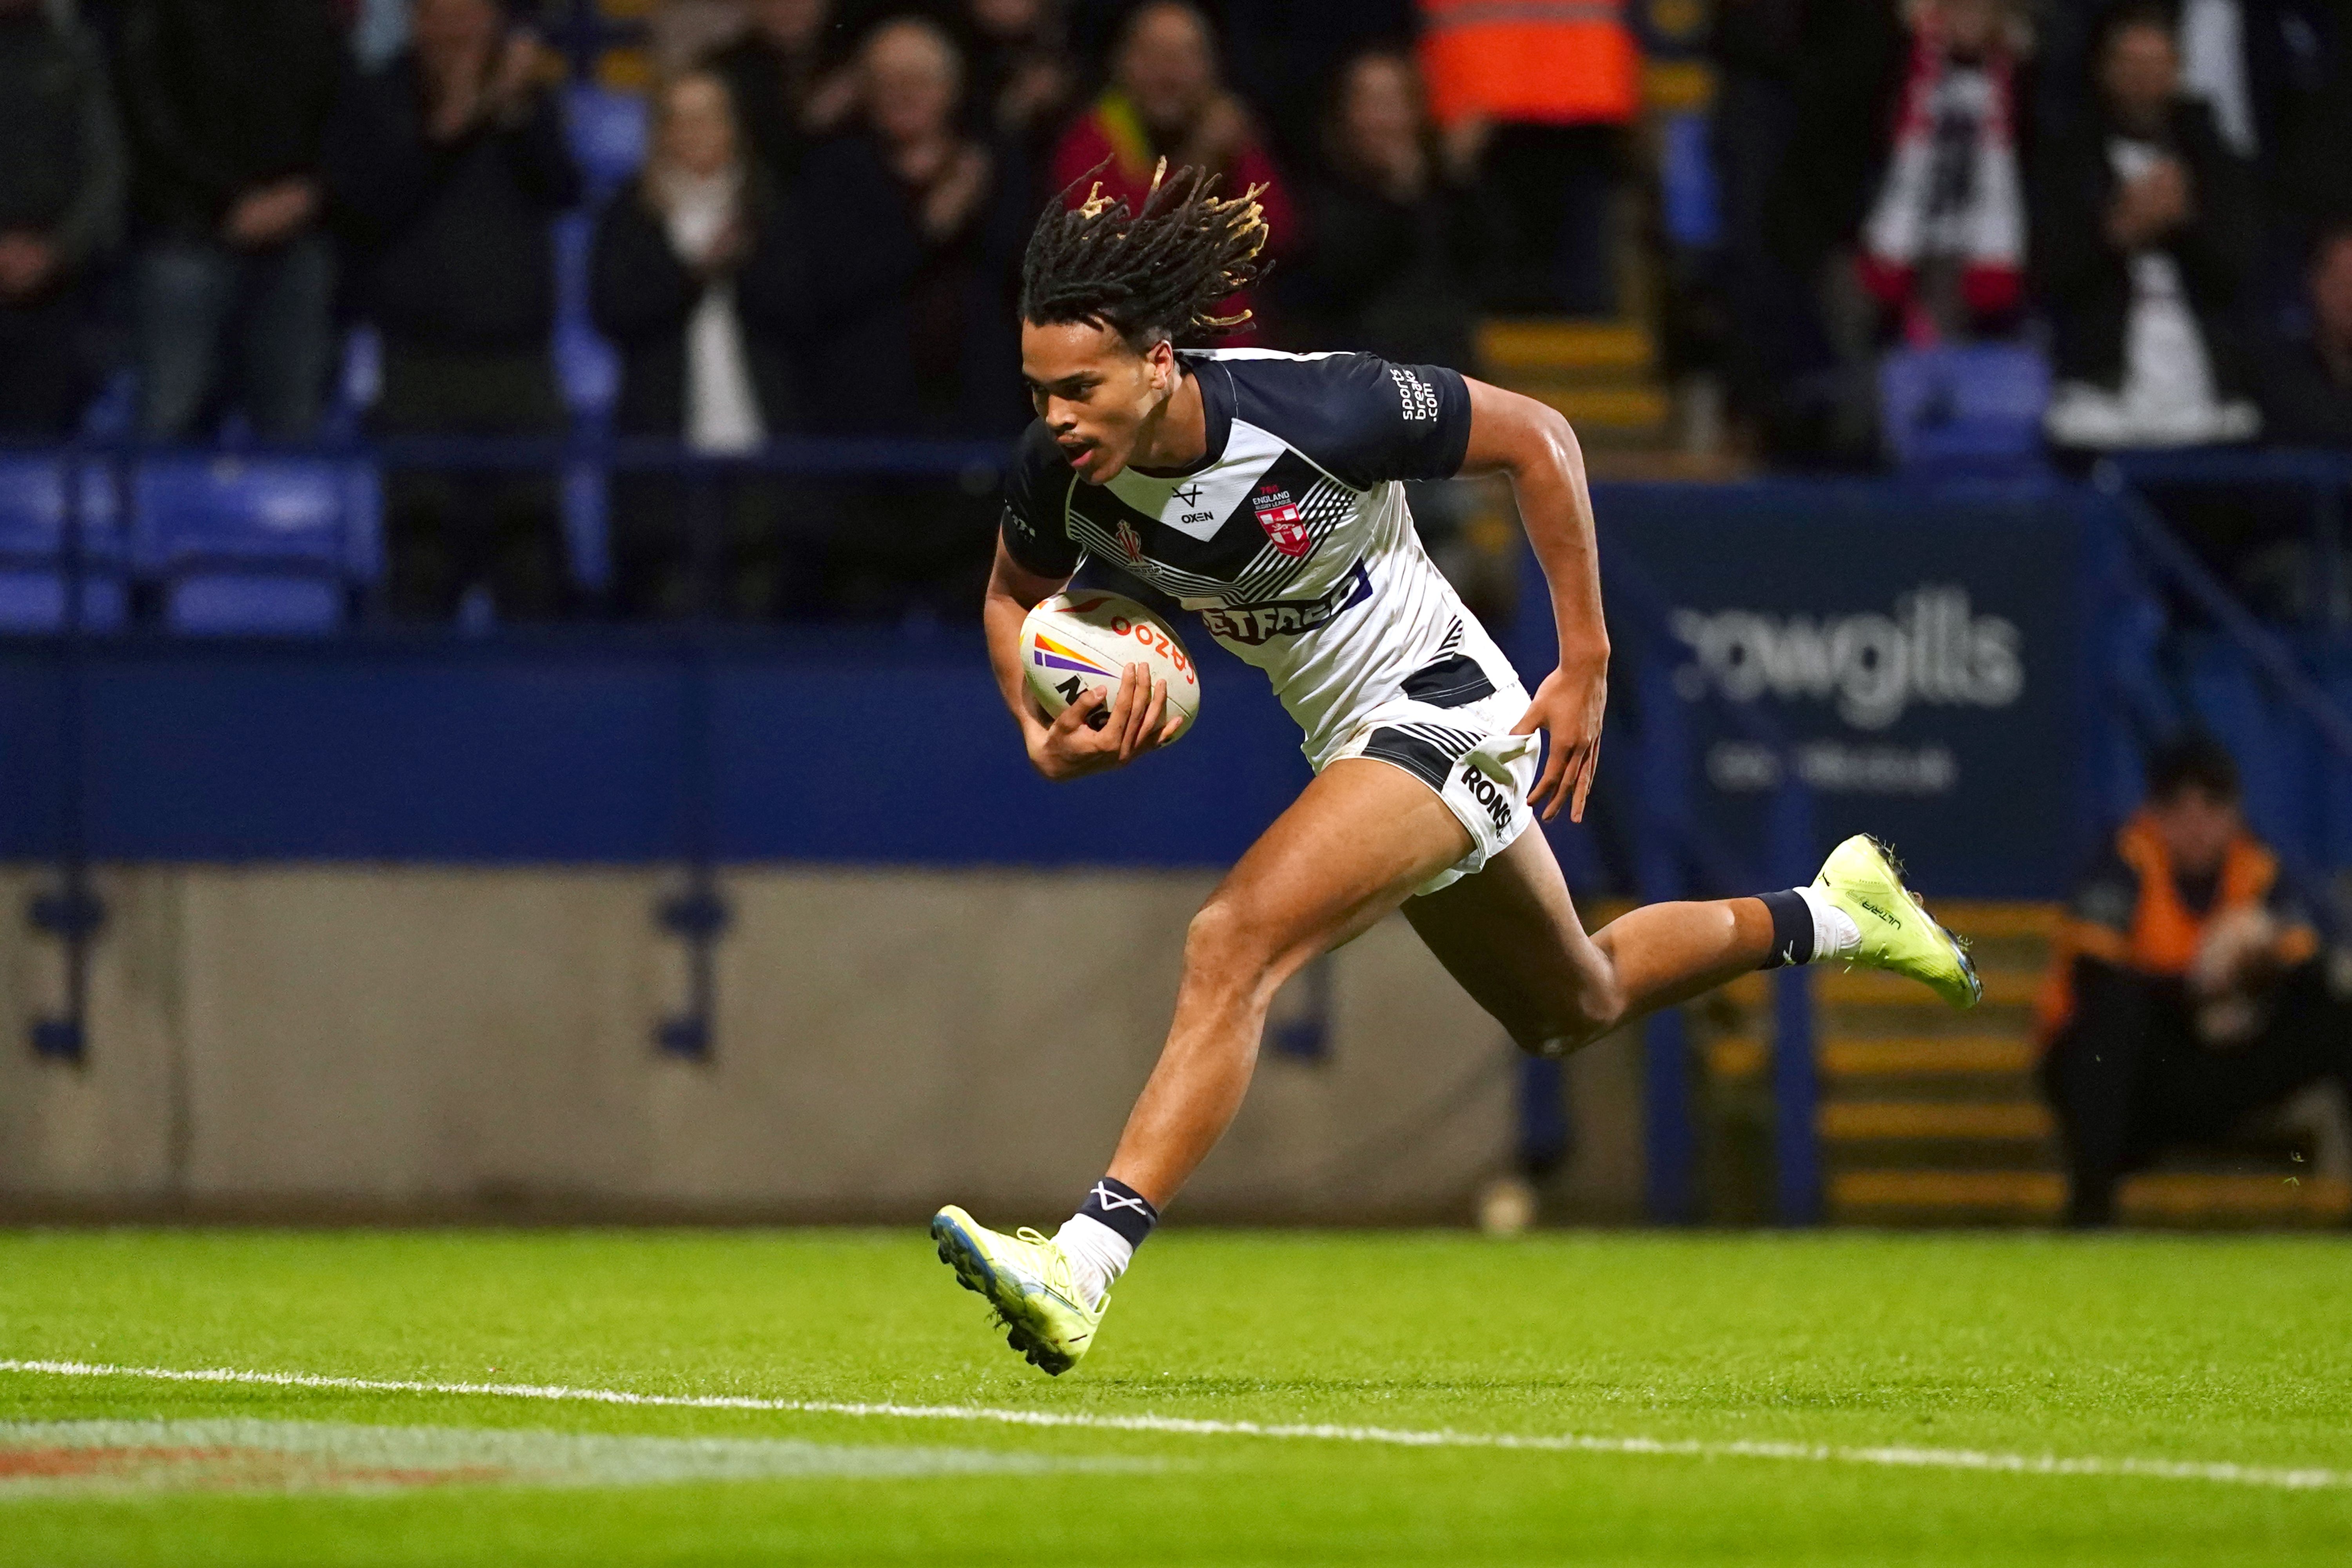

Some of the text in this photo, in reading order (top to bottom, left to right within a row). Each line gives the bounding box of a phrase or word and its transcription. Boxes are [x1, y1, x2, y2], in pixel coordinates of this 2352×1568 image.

[1389, 368, 1415, 421] sports
[1402, 368, 1426, 420] breaks
[1423, 383, 1438, 422] .com
[1181, 511, 1214, 524] OXEN
[1252, 490, 1290, 505] ENGLAND
[1202, 575, 1360, 640] ETFRED
[1461, 764, 1512, 838] RONS
[1862, 900, 1901, 931] ULTRA
